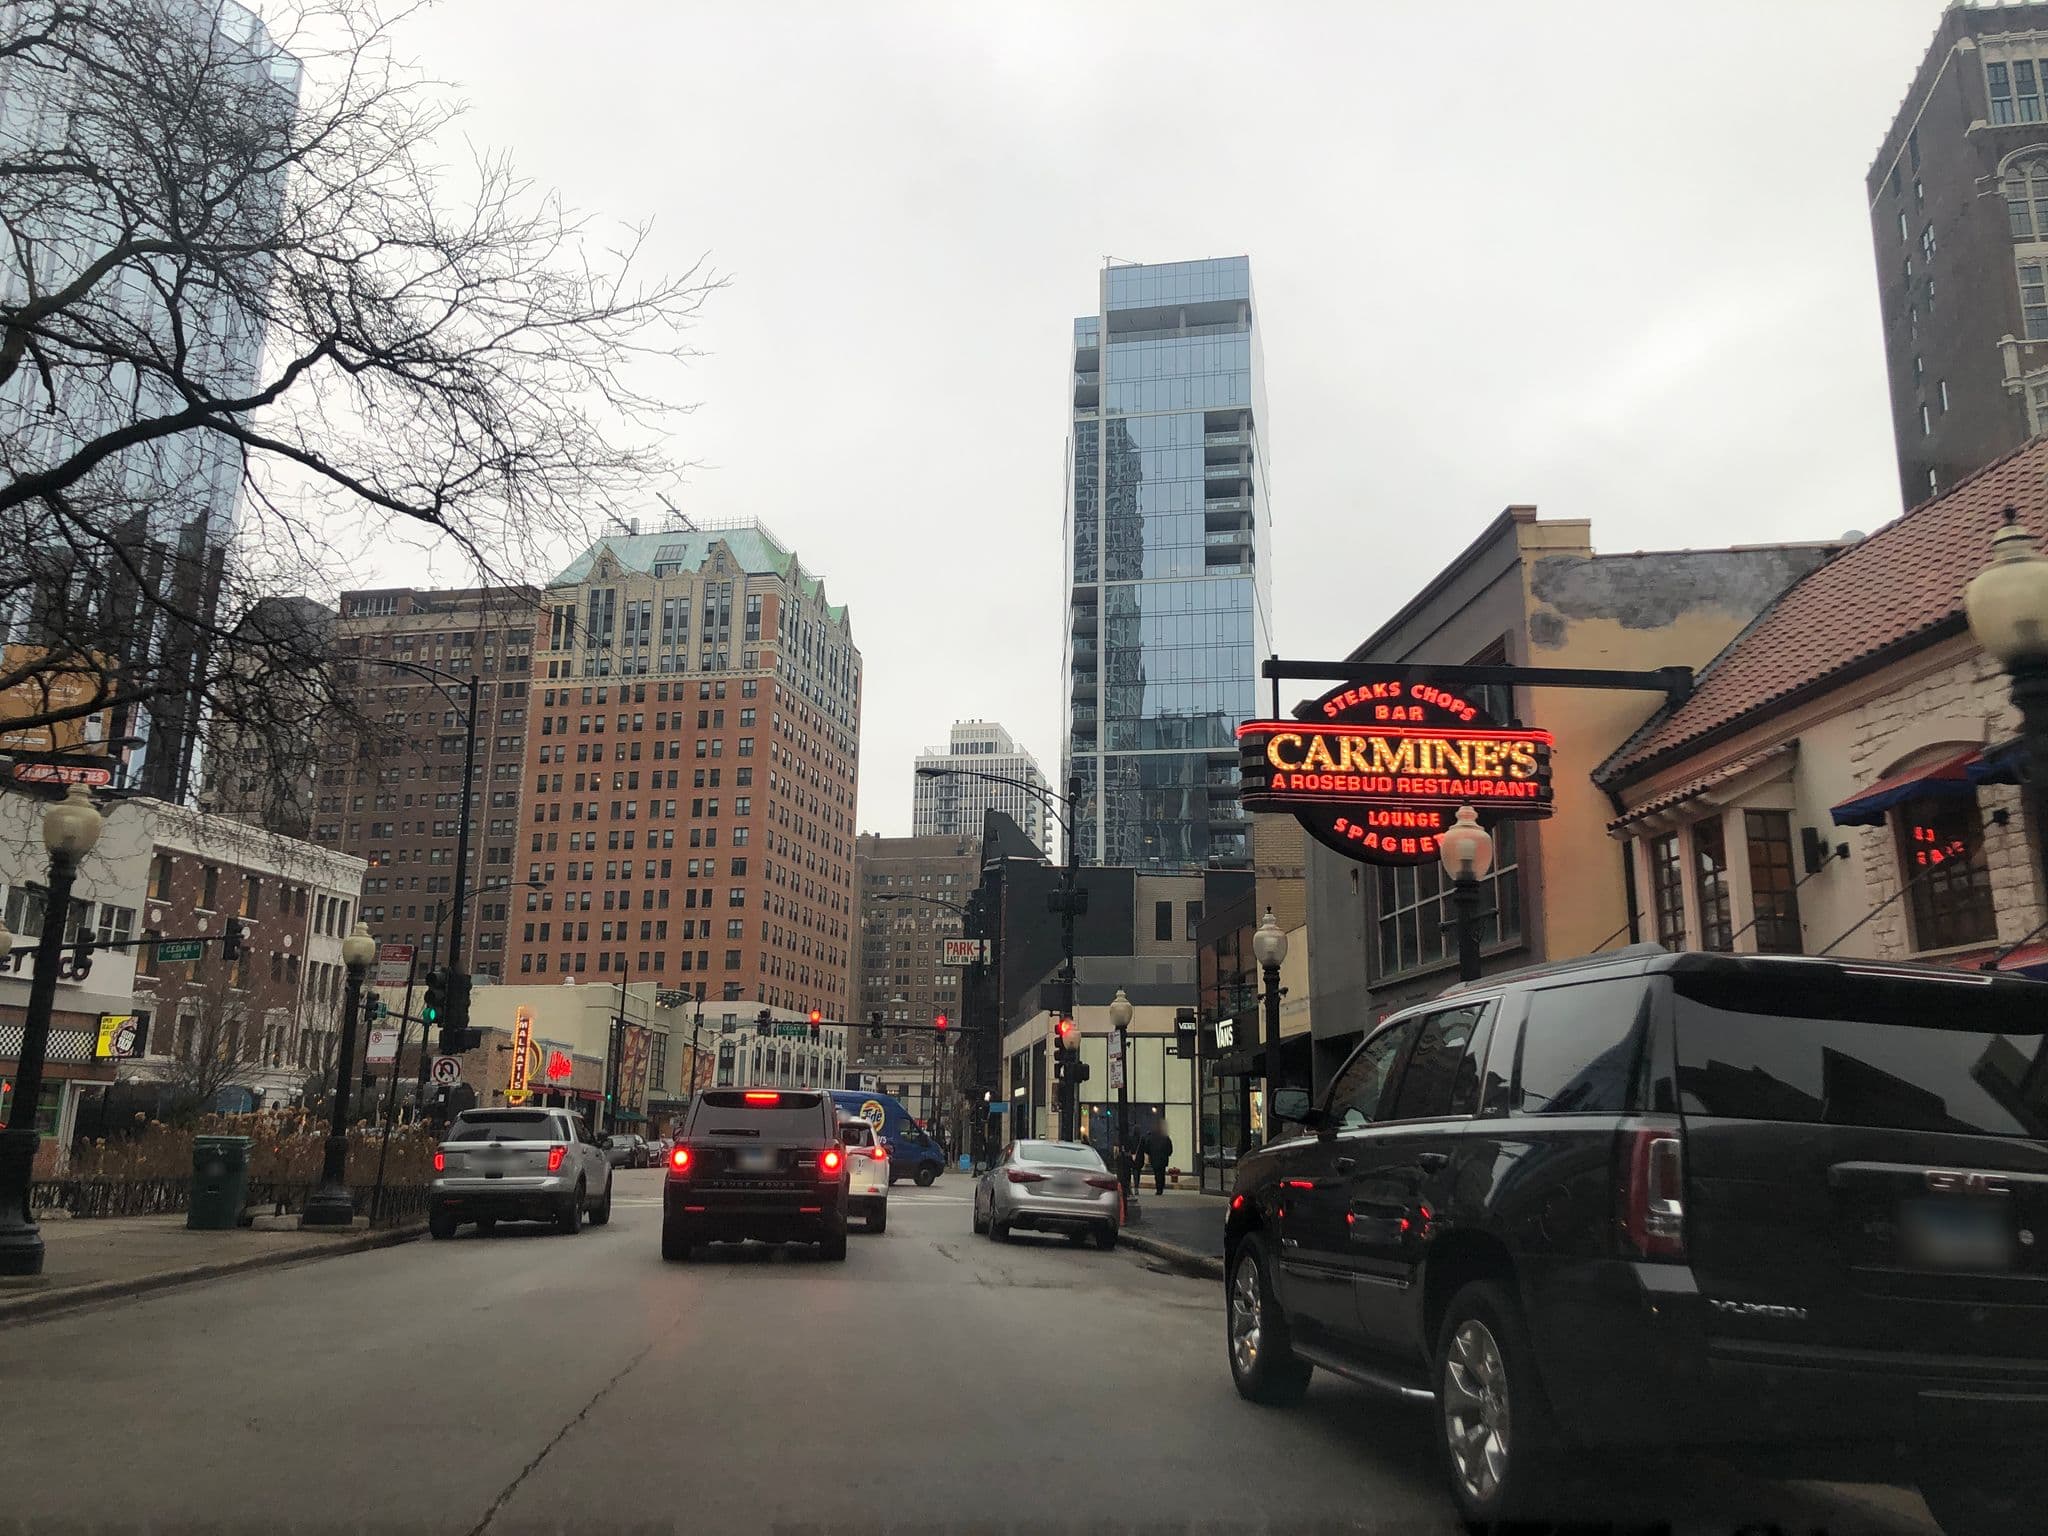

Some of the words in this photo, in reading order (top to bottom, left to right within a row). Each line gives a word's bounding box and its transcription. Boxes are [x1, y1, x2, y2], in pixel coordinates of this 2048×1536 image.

[1323, 681, 1400, 717] STEAKS
[1411, 684, 1477, 720] CHOPS
[1375, 705, 1424, 720] BAR
[1267, 733, 1538, 778] CARMINE'S
[1271, 773, 1286, 789] A
[1291, 774, 1392, 792] ROSEBUD
[1397, 777, 1538, 797] RESTAURANT
[1368, 811, 1441, 827] LOUNGE
[1333, 817, 1446, 853] SPAGHET
[946, 941, 974, 955] PARK
[946, 955, 960, 963] EAST
[1179, 1022, 1196, 1030] VANS
[1215, 1018, 1233, 1049] VANS
